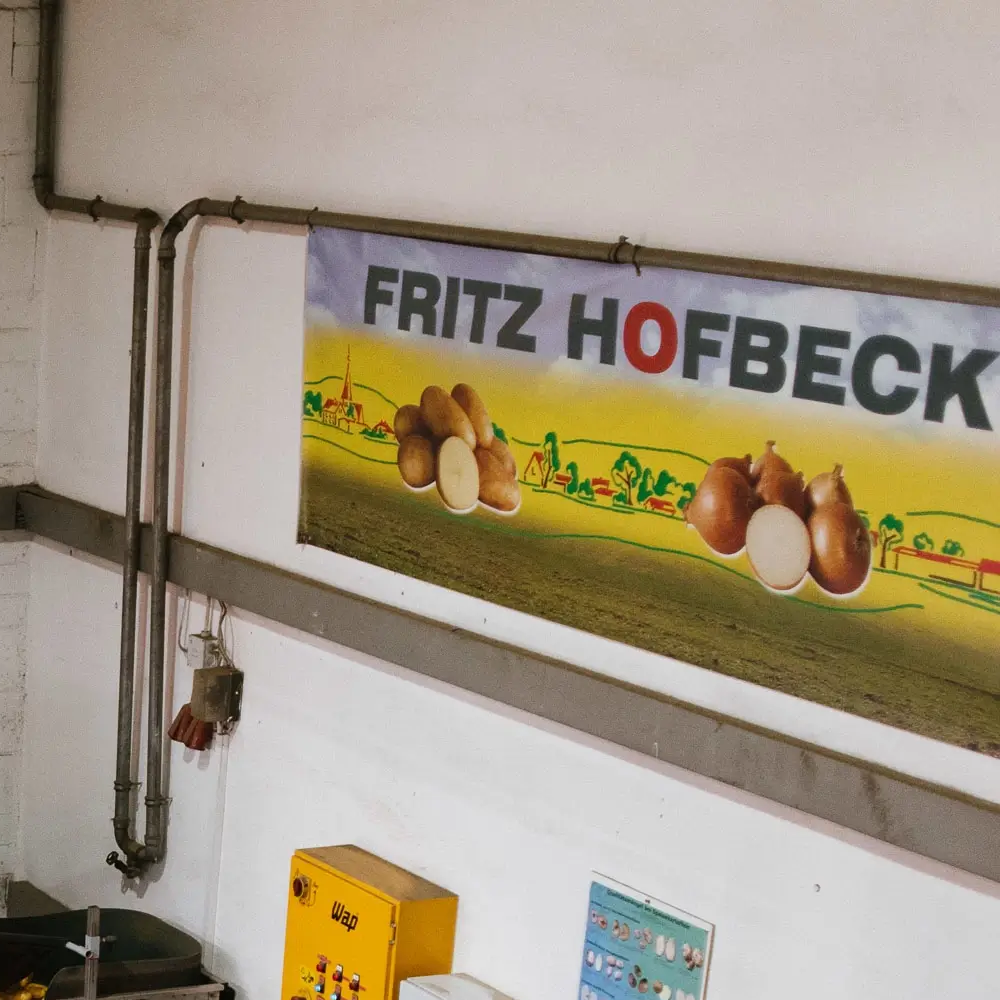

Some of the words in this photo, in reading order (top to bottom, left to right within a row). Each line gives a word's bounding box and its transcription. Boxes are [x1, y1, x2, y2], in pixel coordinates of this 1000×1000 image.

[364, 264, 543, 354] FRITZ
[567, 293, 1000, 431] HOFBECK
[331, 901, 359, 932] Wap
